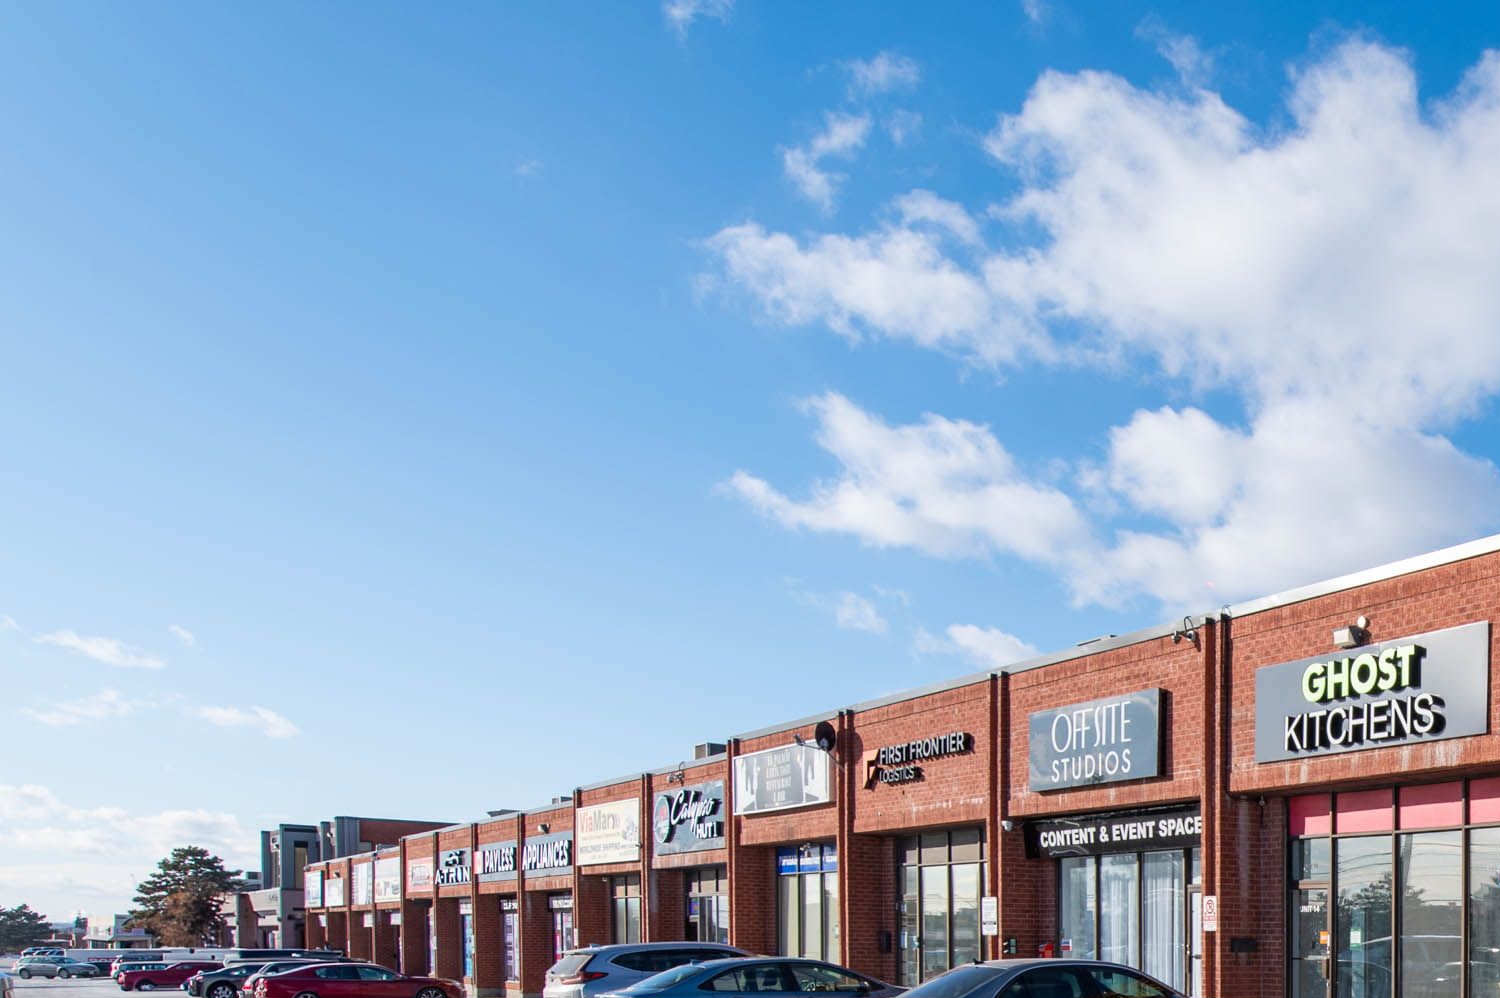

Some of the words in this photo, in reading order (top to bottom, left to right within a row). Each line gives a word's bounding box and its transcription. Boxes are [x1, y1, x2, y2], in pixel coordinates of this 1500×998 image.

[1302, 644, 1415, 702] GHOST
[1051, 700, 1132, 753] OFFSITE
[1285, 693, 1435, 751] KITCHENS
[880, 742, 908, 765] FIRST
[909, 731, 965, 760] FRONTIER
[880, 765, 915, 783] LOGISTICS
[1051, 749, 1132, 783] STUDIOS
[670, 789, 714, 836] Calypso
[1040, 827, 1096, 848] CONTENT
[1100, 825, 1109, 842] &
[1112, 820, 1156, 842] EVENT
[1158, 815, 1202, 837] SPACE
[484, 846, 514, 873] PAYLESS
[522, 840, 569, 871] APPLIANCES
